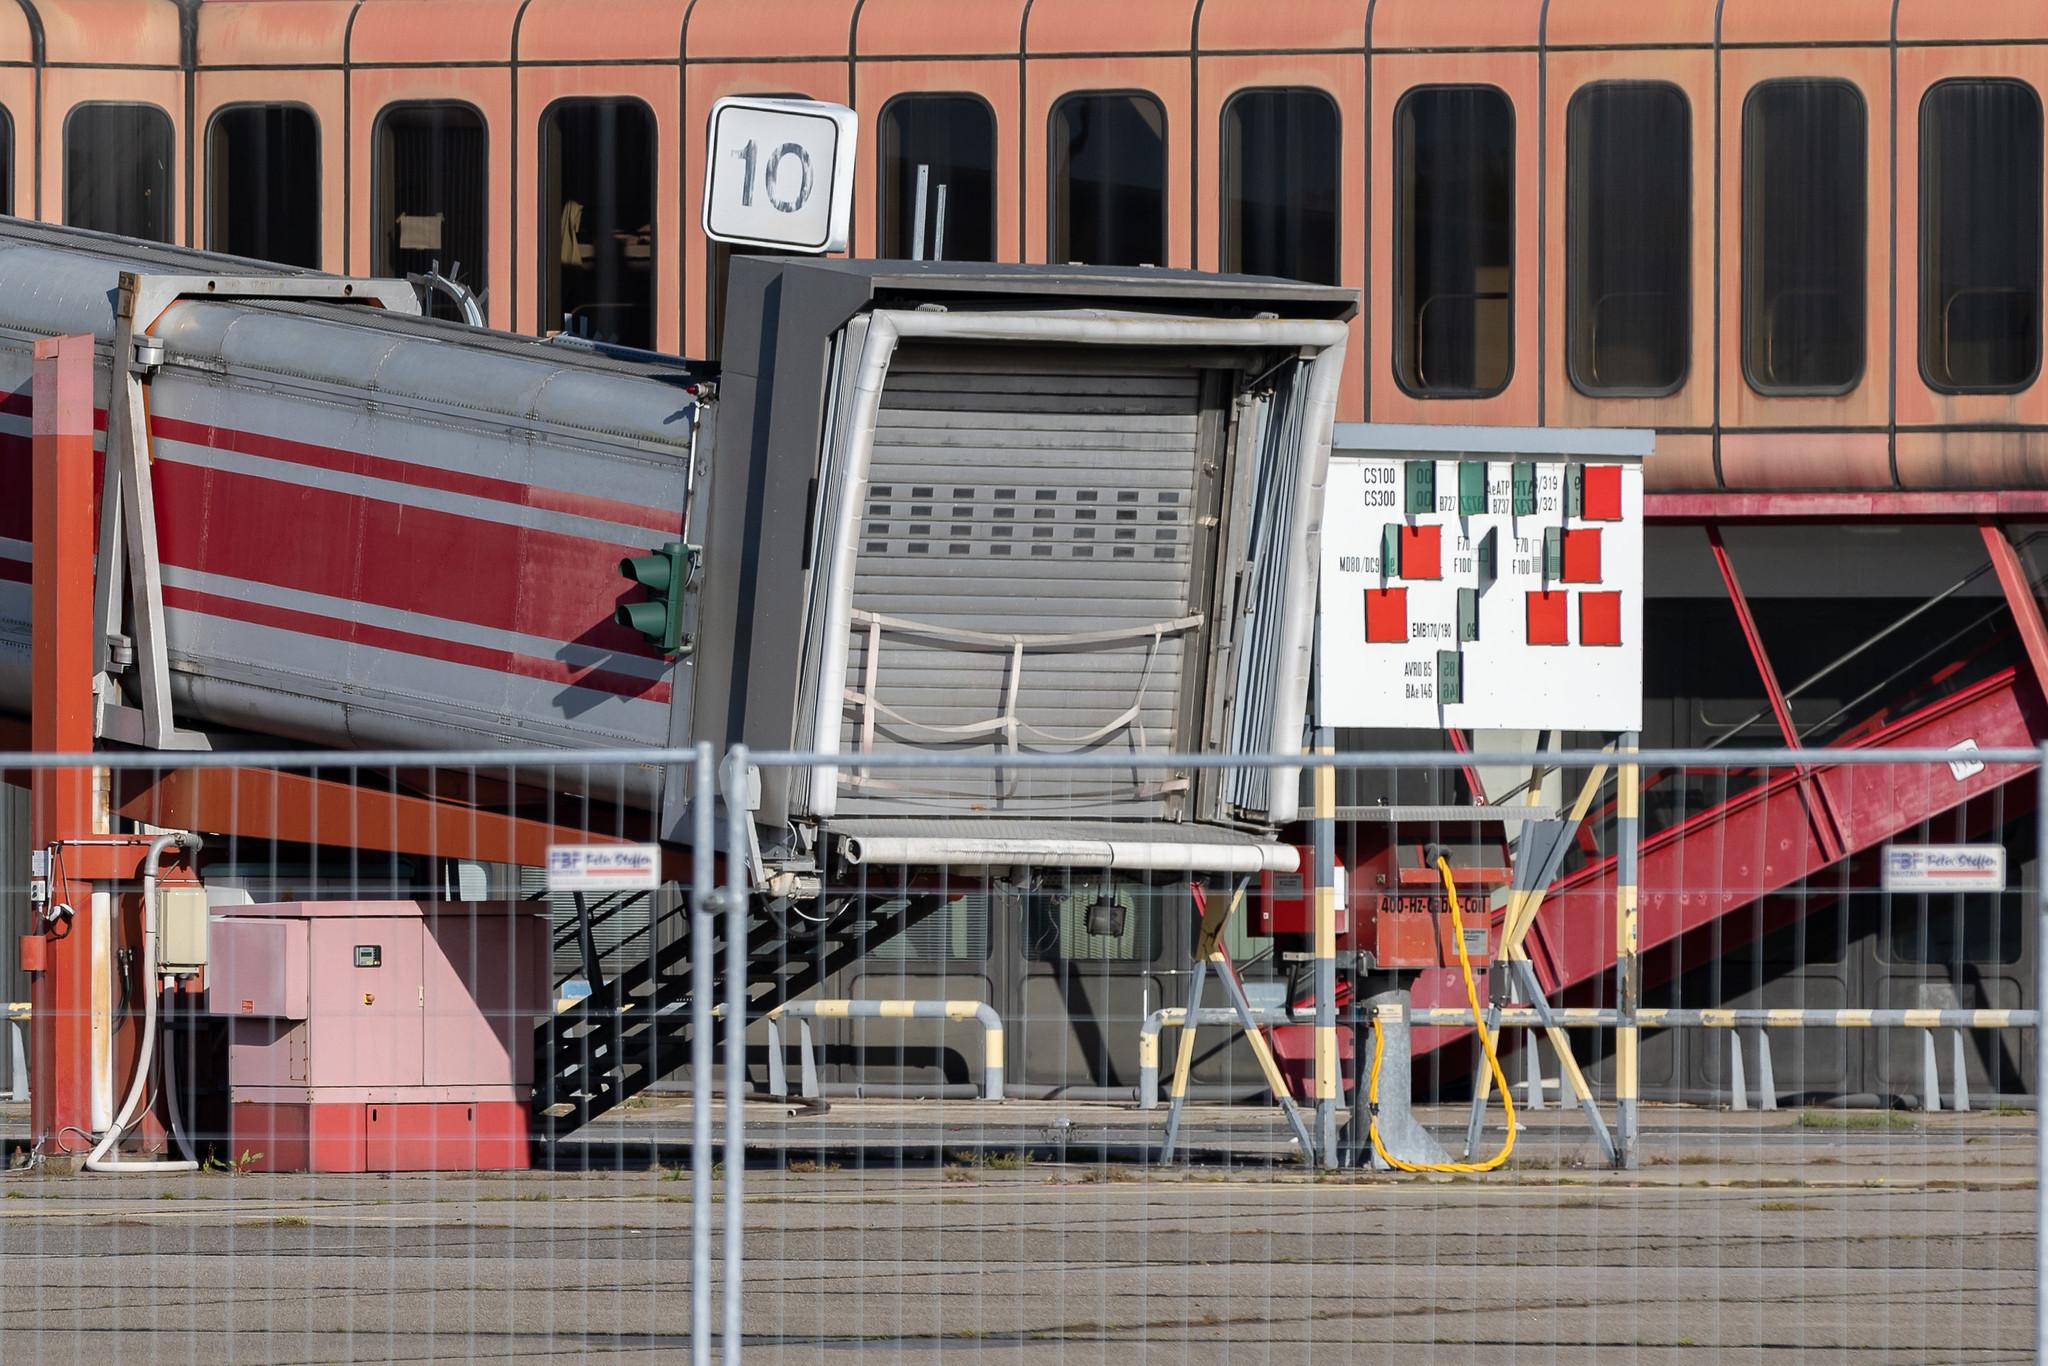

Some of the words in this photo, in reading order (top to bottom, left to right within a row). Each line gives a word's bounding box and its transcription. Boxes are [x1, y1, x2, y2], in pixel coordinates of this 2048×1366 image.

[731, 139, 814, 213] 10
[1363, 467, 1396, 484] CS100
[1364, 490, 1396, 507] CS300
[1439, 495, 1457, 512] B727
[1492, 498, 1510, 514] B737
[1457, 535, 1471, 552] F70
[1515, 537, 1529, 553] F70
[1453, 557, 1472, 573] F100
[1512, 559, 1531, 575] F100
[1412, 622, 1452, 640] EMB170/190
[1404, 661, 1422, 677] AVRO
[1405, 683, 1420, 699] BAe
[1420, 683, 1433, 699] 146
